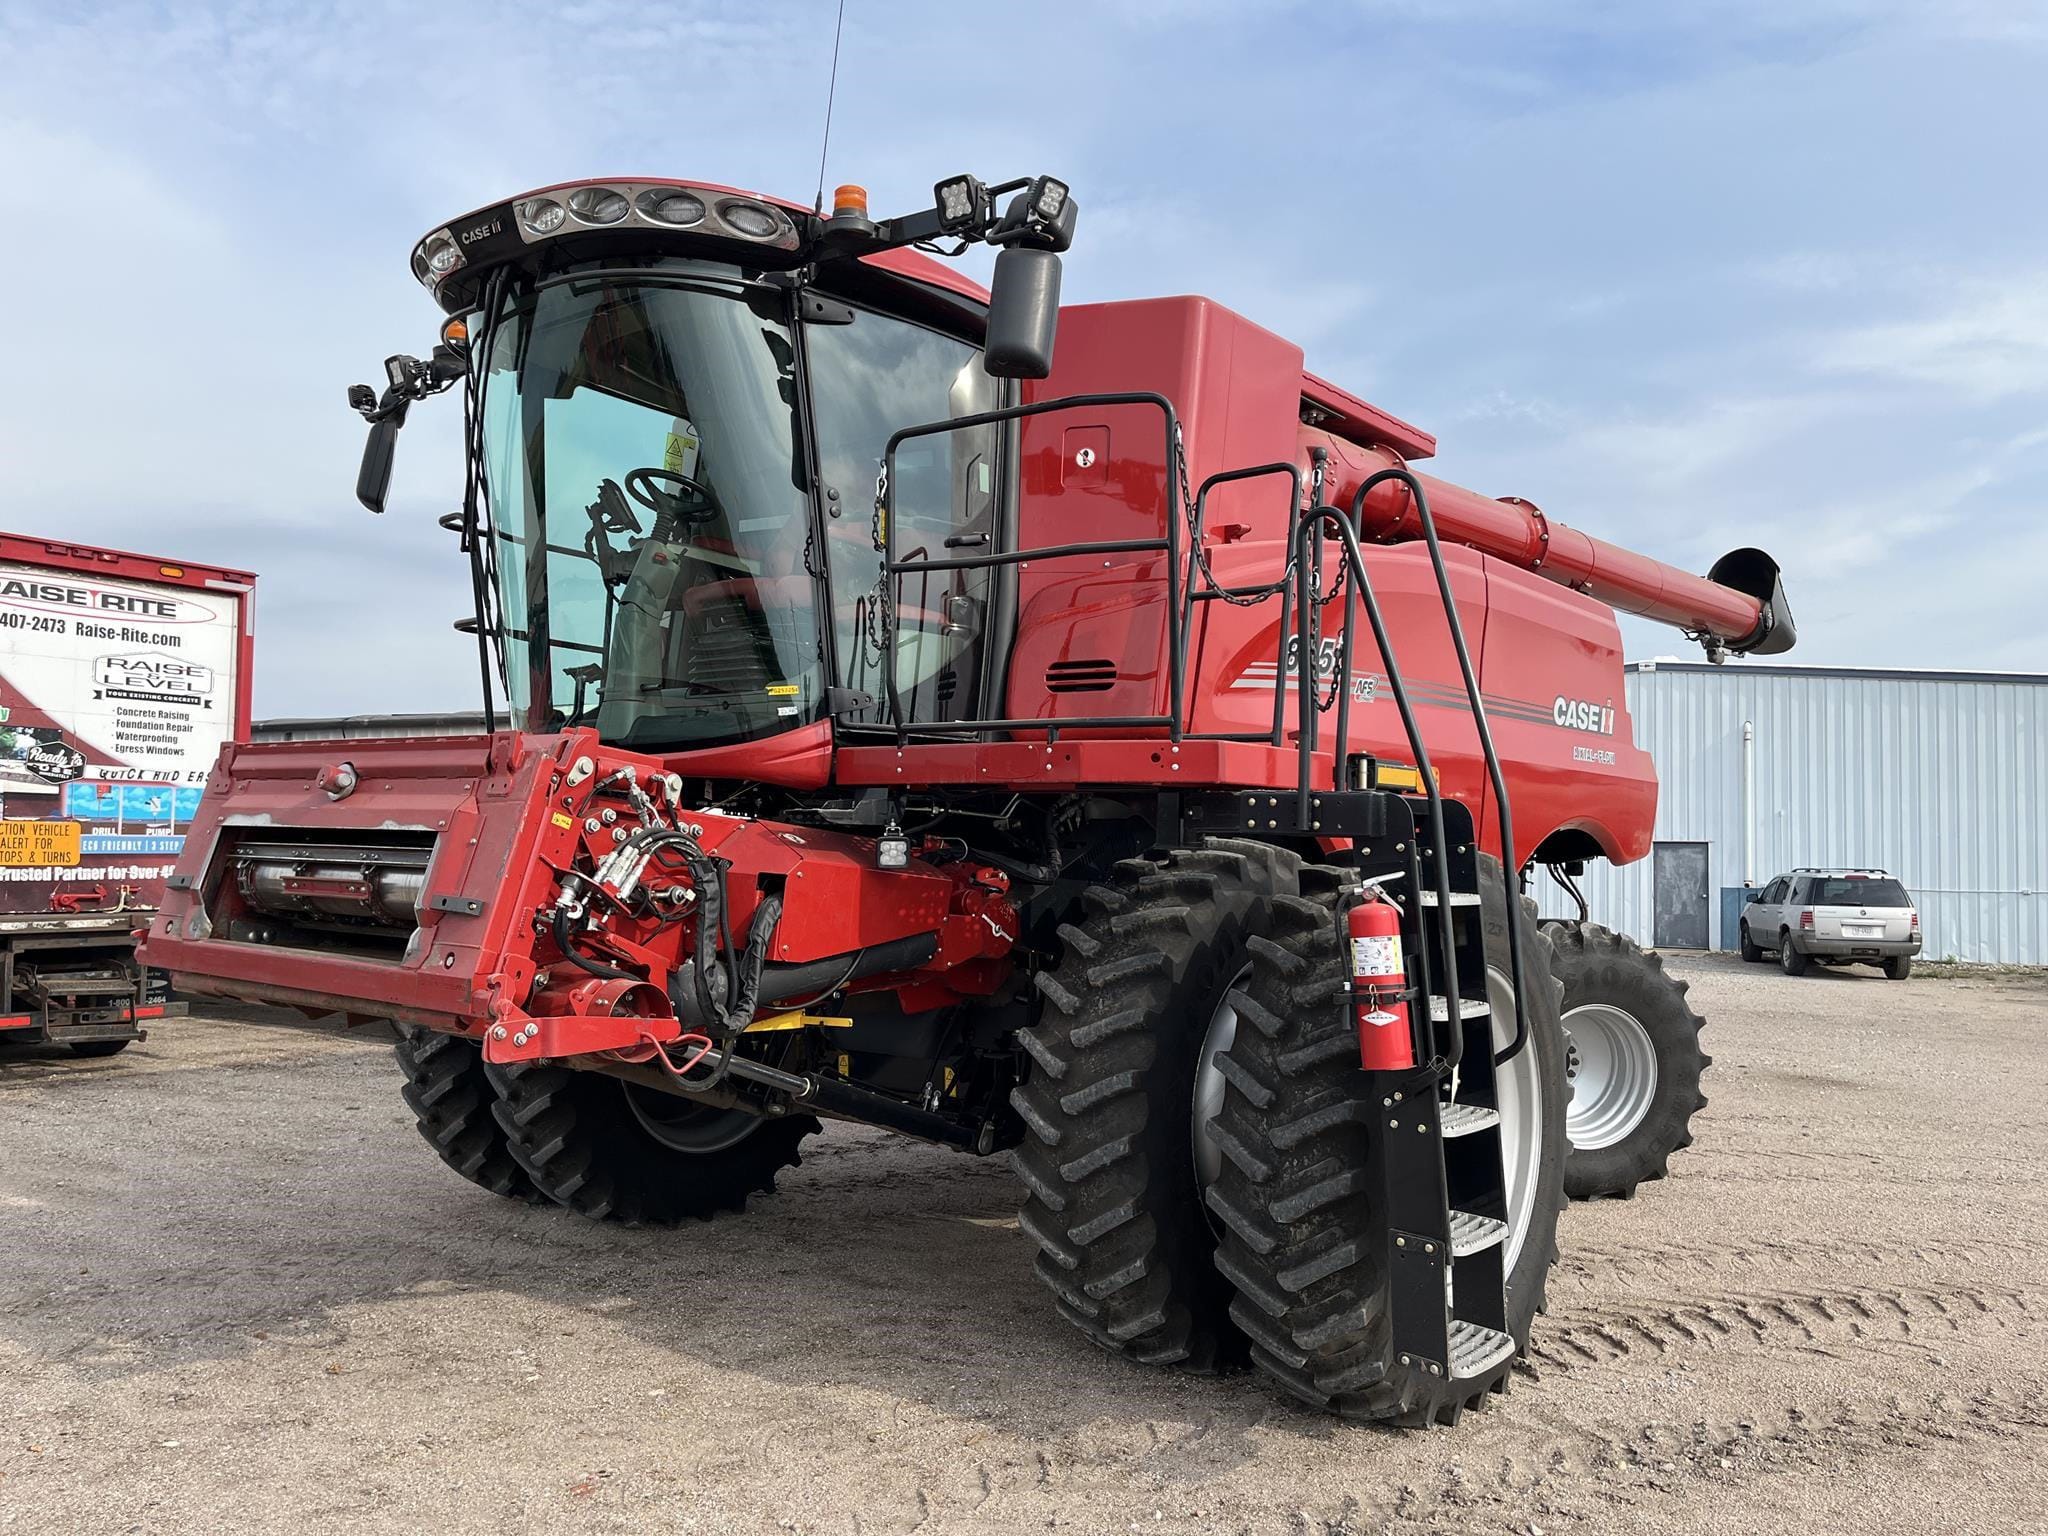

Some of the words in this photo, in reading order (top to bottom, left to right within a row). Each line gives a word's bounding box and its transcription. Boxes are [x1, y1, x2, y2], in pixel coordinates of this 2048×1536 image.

[462, 225, 491, 245] CASE
[0, 580, 88, 606] AISE
[101, 594, 177, 617] RITE
[76, 621, 181, 648] Raise-Rite.com
[106, 657, 205, 678] RAISE
[103, 674, 206, 694] LEVEL
[107, 690, 129, 698] YOUR
[129, 692, 162, 701] EXISTING
[116, 706, 157, 718] Concrete
[158, 710, 190, 721] Raising
[1553, 696, 1600, 732] CASE
[116, 719, 165, 731] Foundation
[166, 722, 194, 733] Repair
[115, 731, 178, 744] Waterproofing
[115, 743, 144, 754] Egress
[146, 745, 185, 756] Windows
[29, 746, 68, 768] Ready
[99, 768, 145, 780] QUICK
[33, 823, 70, 837] VEHICLE
[92, 827, 118, 836] DRILL
[145, 828, 171, 836] PUMP
[0, 837, 29, 849] ALERT
[35, 837, 53, 849] FOR
[101, 840, 142, 851] FRIENDLY
[159, 841, 180, 851] STEP
[28, 851, 36, 863] &
[43, 851, 72, 863] TURNS
[0, 866, 52, 881] Trusted
[54, 866, 106, 881] Partner
[107, 865, 128, 880] for
